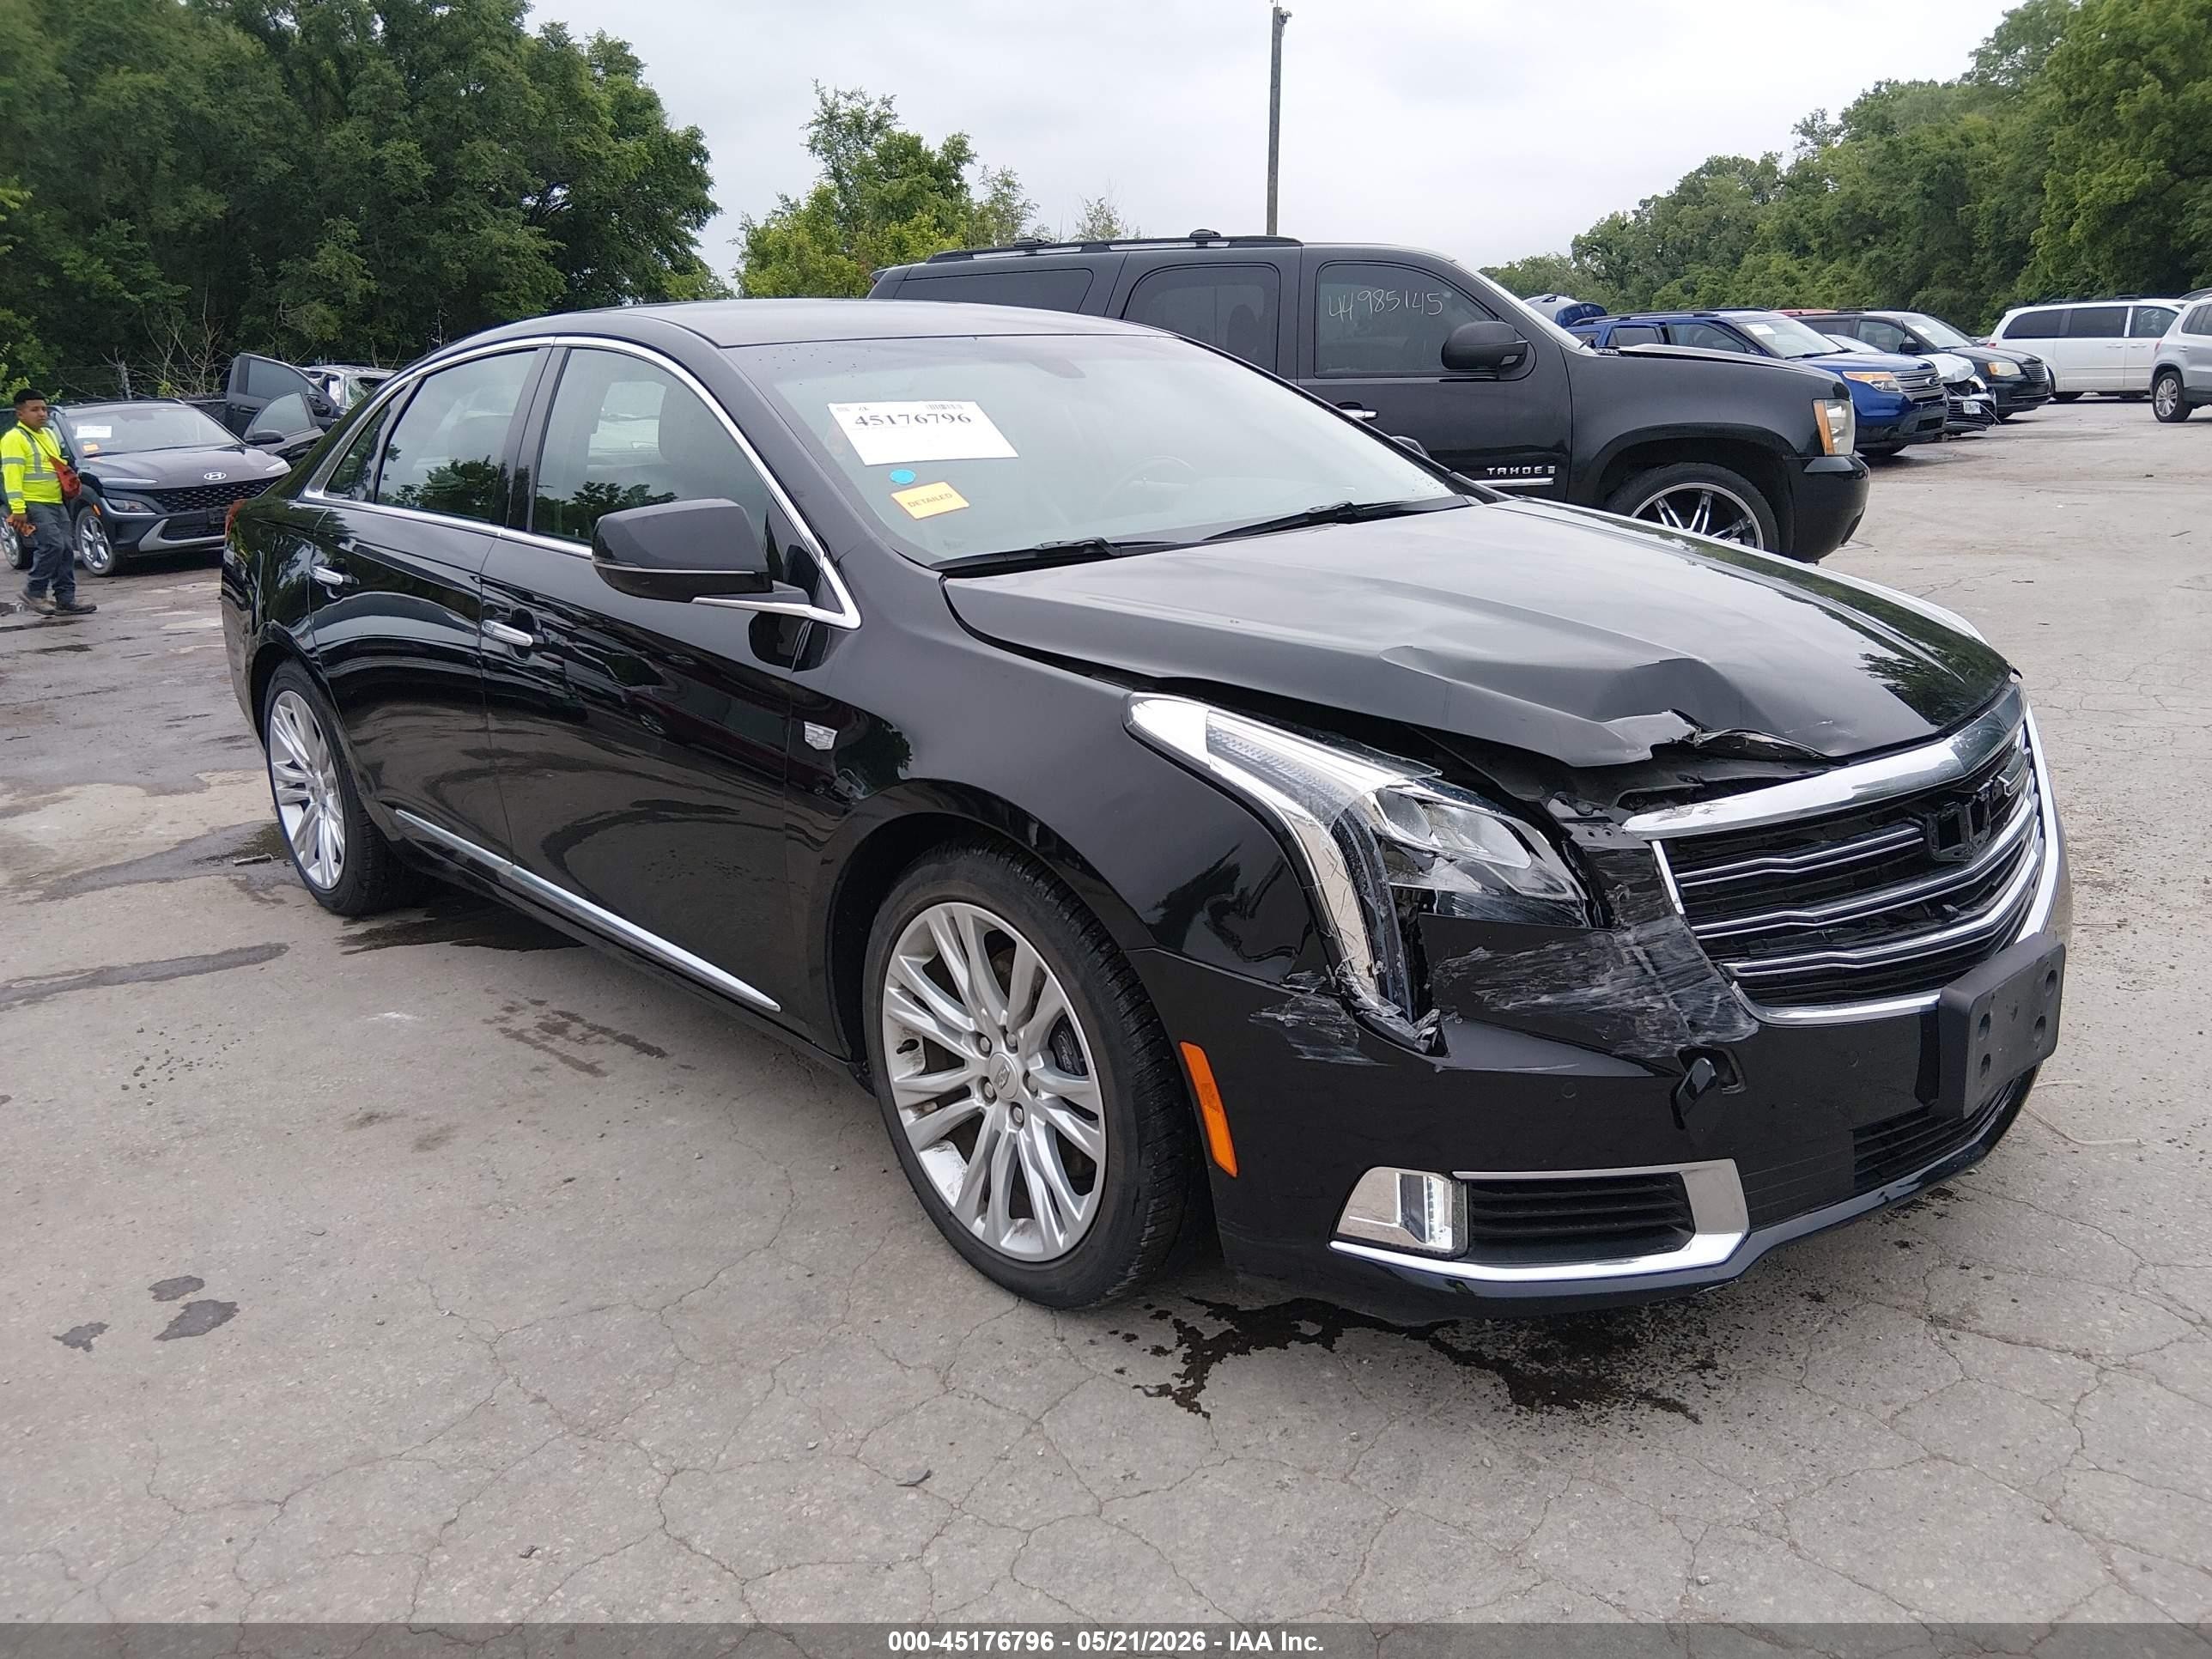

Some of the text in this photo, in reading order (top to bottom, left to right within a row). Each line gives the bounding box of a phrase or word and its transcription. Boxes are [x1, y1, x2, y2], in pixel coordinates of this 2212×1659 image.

[855, 413, 972, 427] 45176796
[1486, 466, 1543, 476] TAHOE
[908, 493, 952, 507] DETAILED
